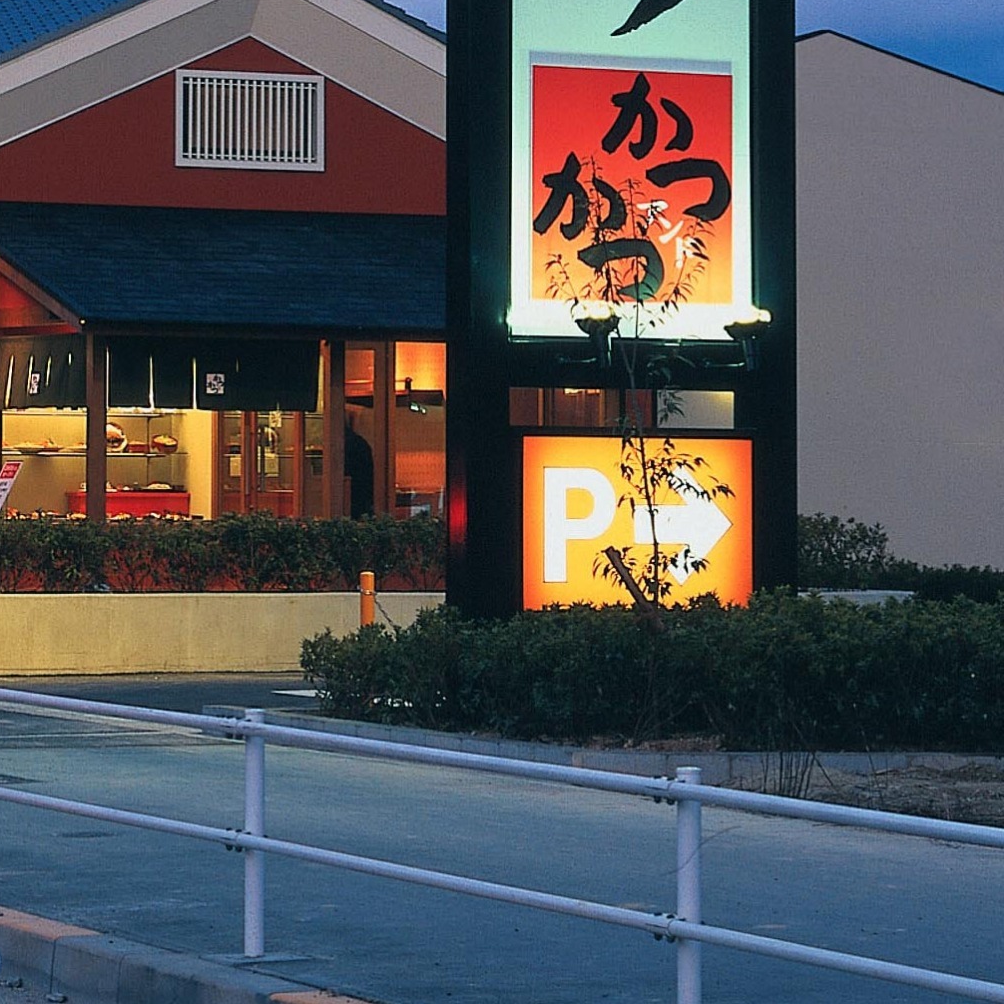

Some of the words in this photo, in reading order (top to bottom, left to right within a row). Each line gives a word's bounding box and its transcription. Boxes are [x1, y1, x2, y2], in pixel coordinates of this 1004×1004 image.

[601, 72, 732, 221] かつ
[532, 151, 665, 300] かつ
[543, 467, 616, 583] P
